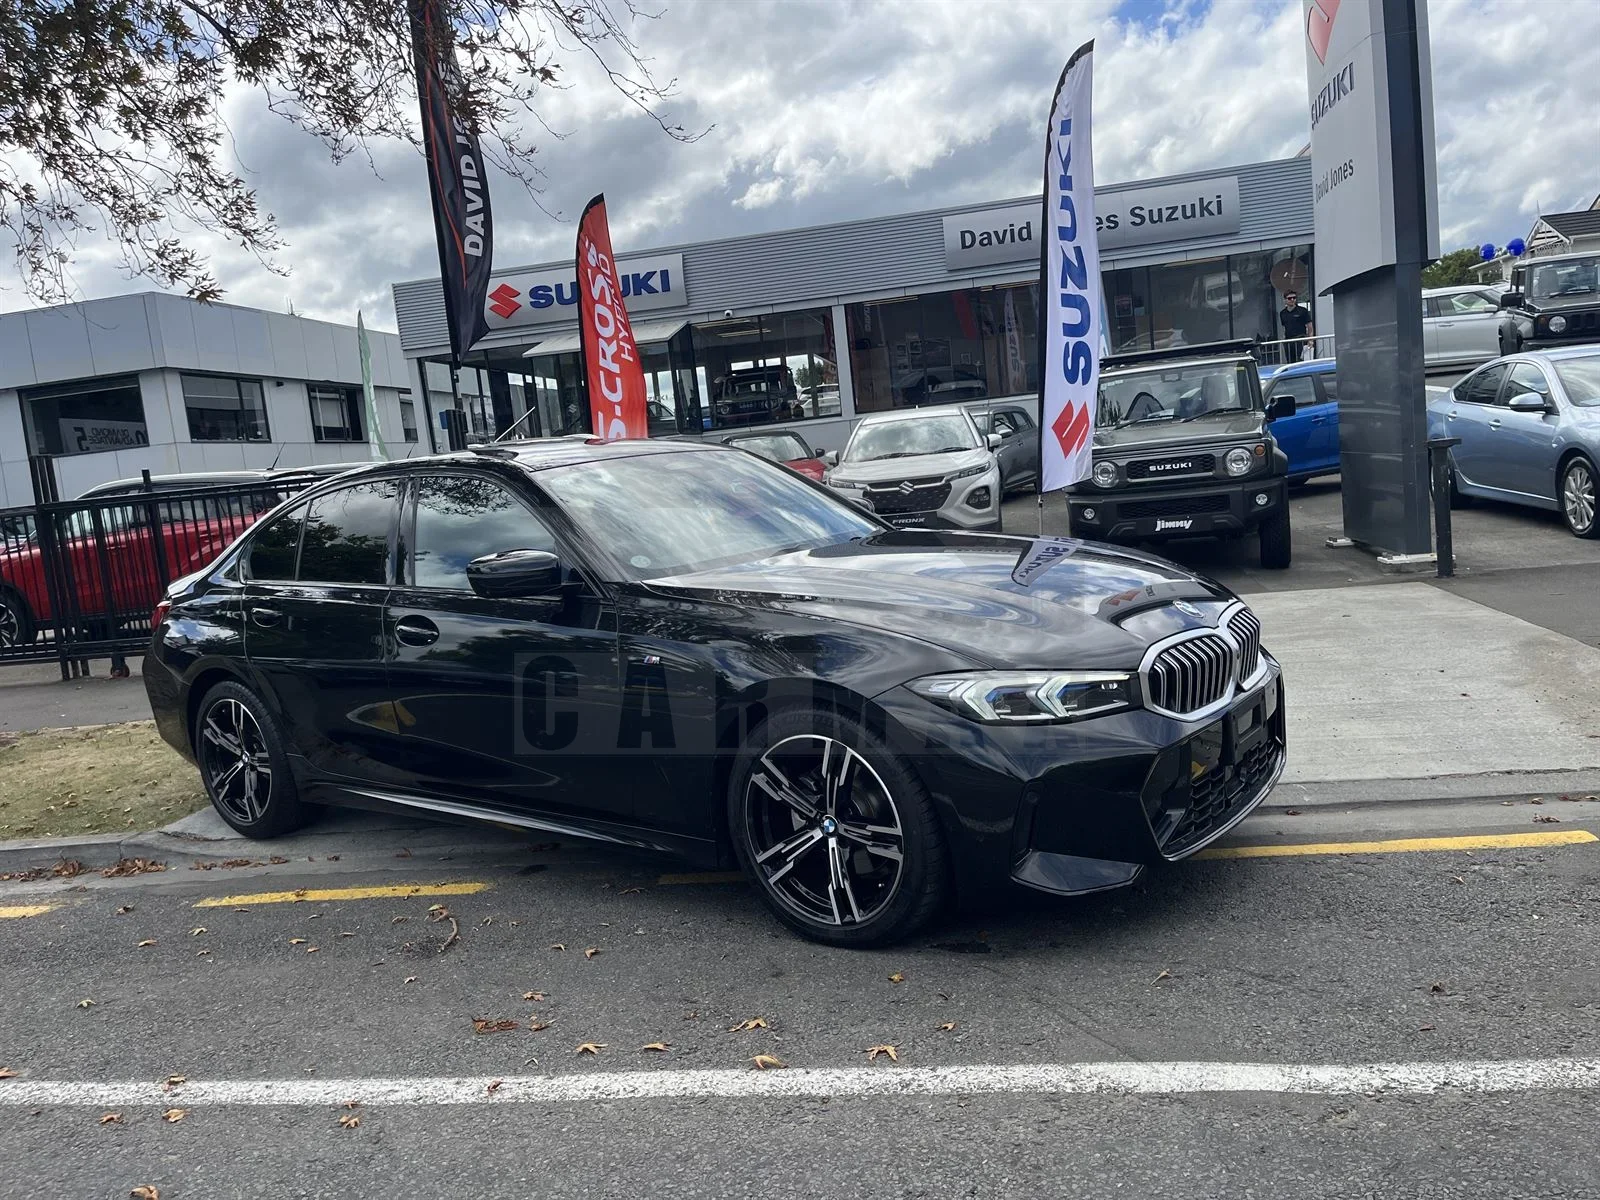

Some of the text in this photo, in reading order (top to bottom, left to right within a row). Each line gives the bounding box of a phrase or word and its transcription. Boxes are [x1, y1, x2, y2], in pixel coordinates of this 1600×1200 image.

[1311, 62, 1354, 130] SUZUKI
[1330, 158, 1355, 190] Jones
[461, 155, 485, 257] DAVID
[960, 221, 1033, 250] David
[1129, 194, 1223, 227] Suzuki
[1057, 119, 1092, 387] SUZUKI
[528, 269, 671, 309] SUKI
[1149, 462, 1192, 472] SUZUKI
